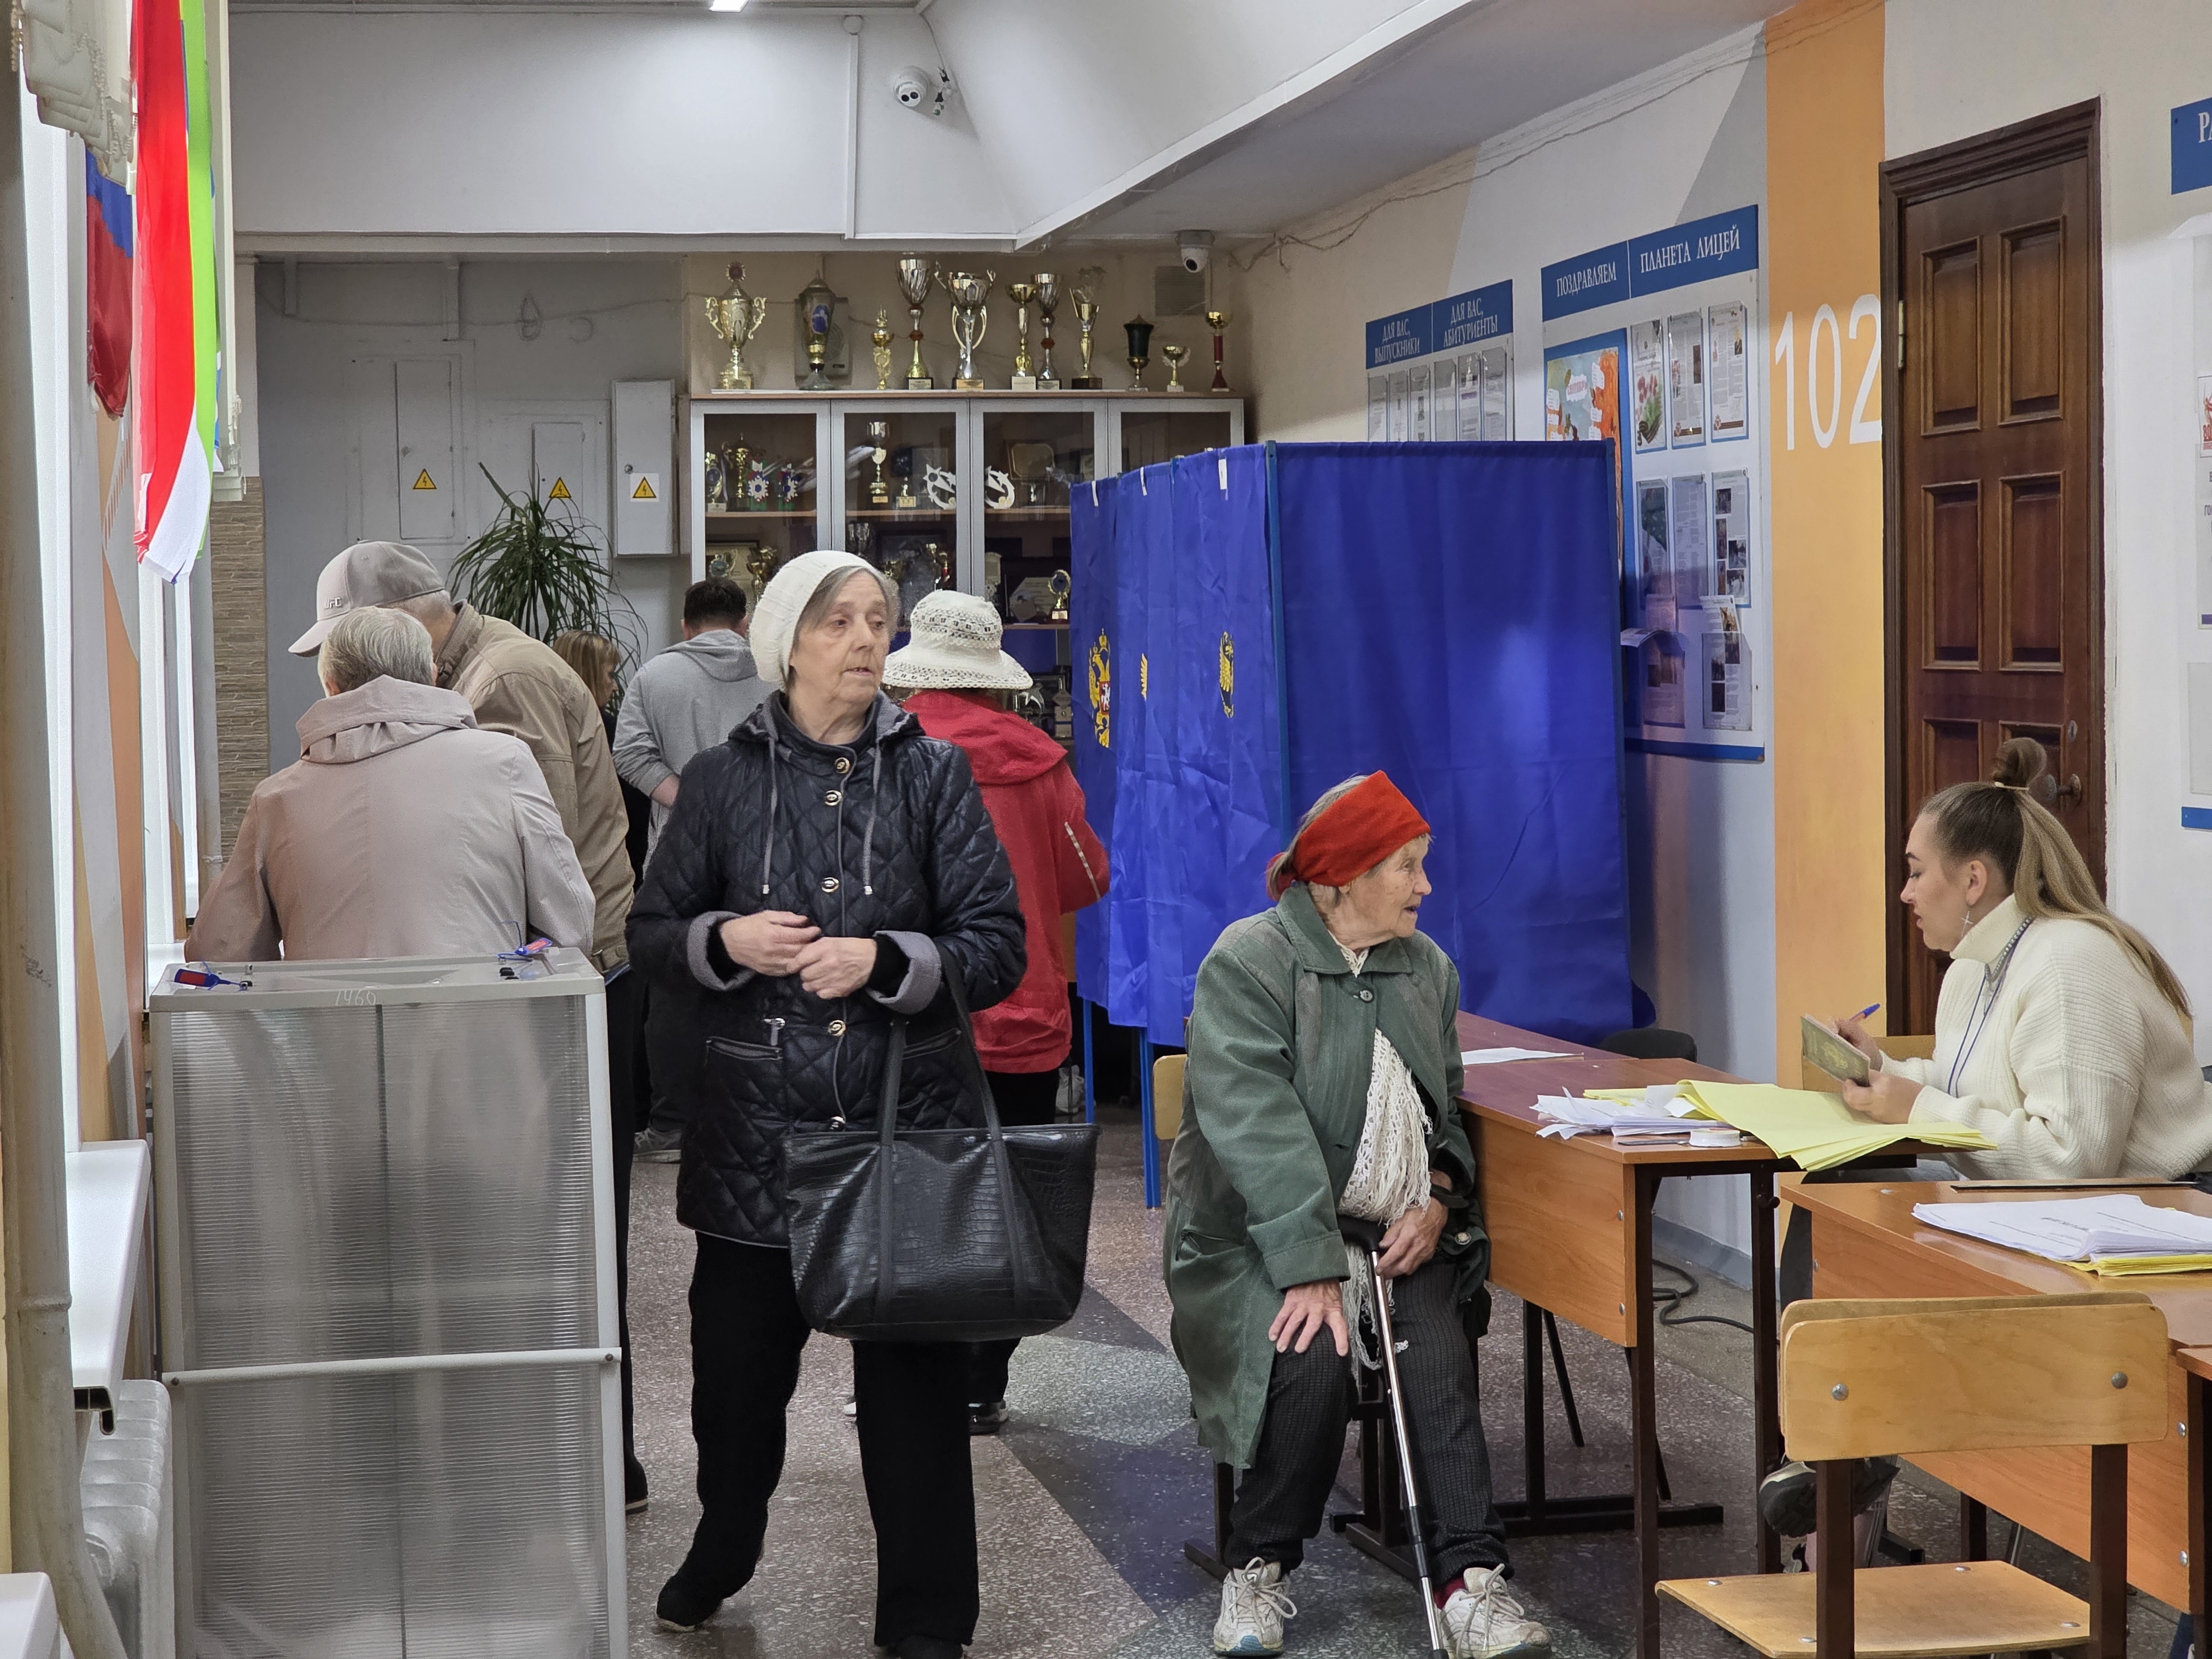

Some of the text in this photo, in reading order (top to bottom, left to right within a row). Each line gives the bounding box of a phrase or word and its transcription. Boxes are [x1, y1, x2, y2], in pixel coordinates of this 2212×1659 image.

[1640, 224, 1740, 273] ПЛАНЕТА ЛИЦЕЙ
[1557, 260, 1617, 297] ПОЗДРАВЛЯЕМ
[1451, 298, 1484, 325] ДЛЯ ВАС,
[1383, 318, 1411, 342] ДЛЯ ВАС,
[1443, 314, 1498, 347] АБИТУРИЕНТЫ
[1375, 337, 1420, 364] ВЫПУСКНИКИ
[1775, 294, 1882, 451] 102
[335, 989, 377, 1006] 1460
